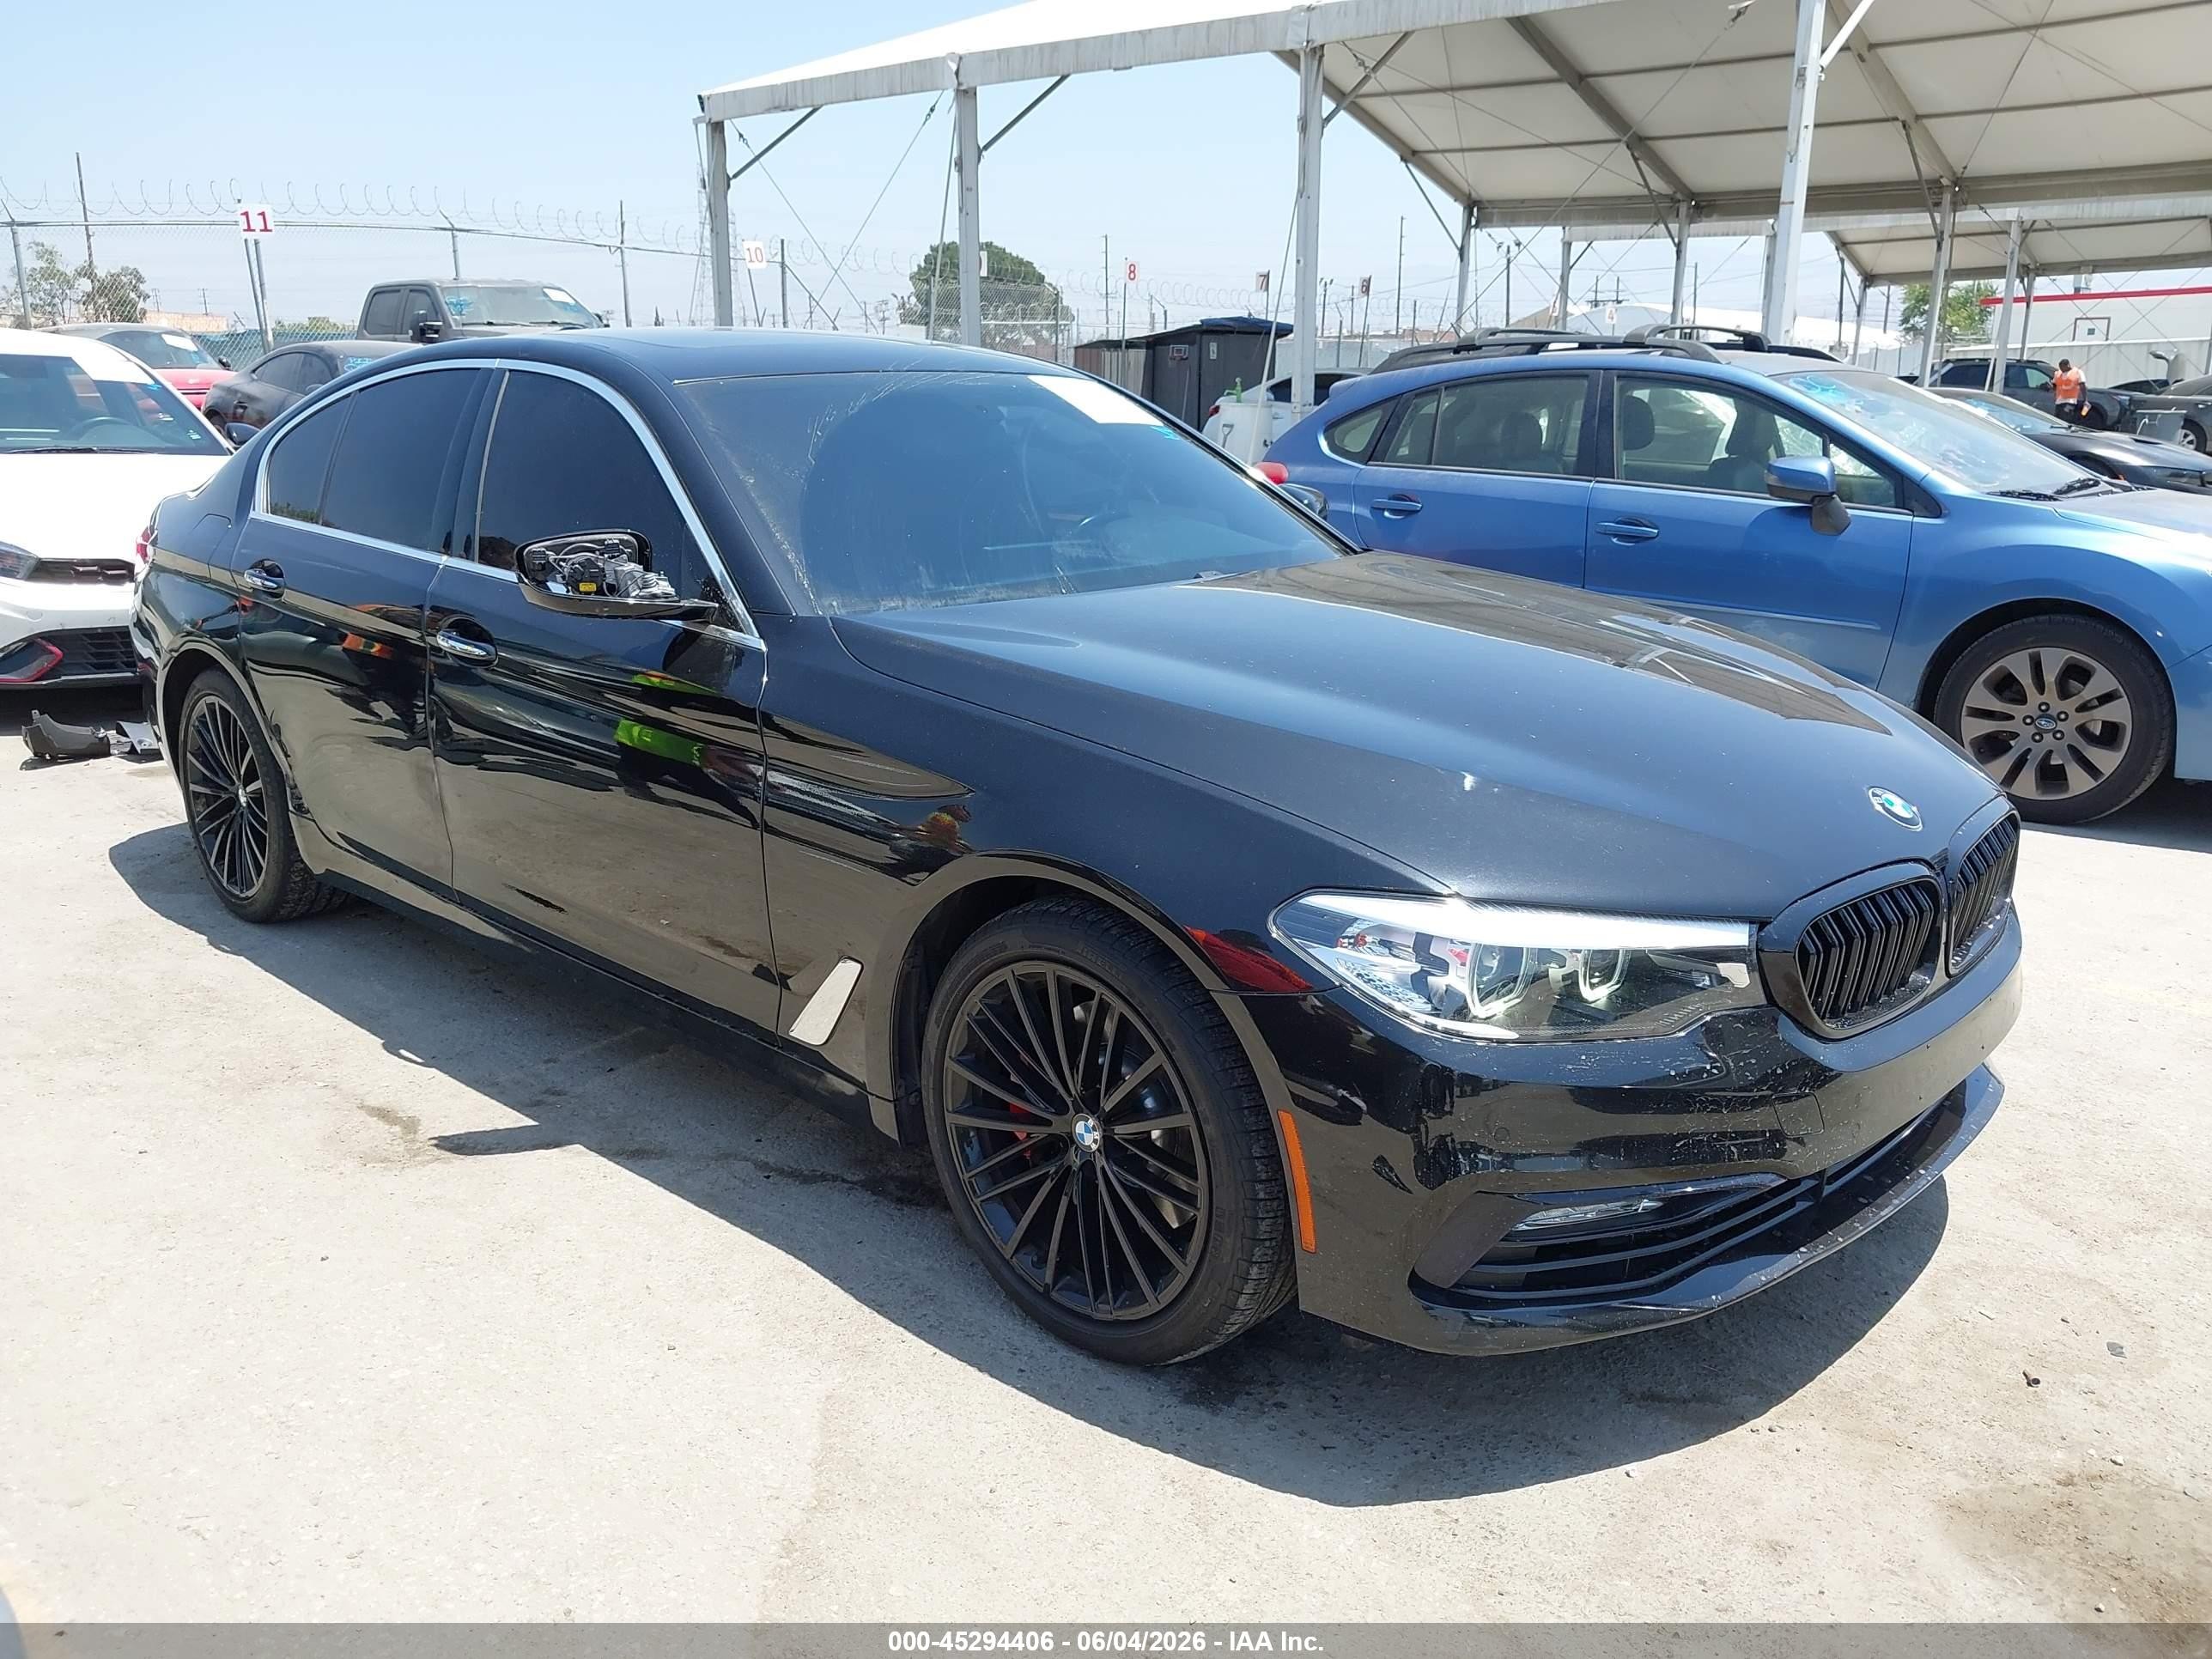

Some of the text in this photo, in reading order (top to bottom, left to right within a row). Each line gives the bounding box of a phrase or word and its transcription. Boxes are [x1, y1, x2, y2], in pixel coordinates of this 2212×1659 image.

[240, 210, 272, 232] 11
[746, 246, 763, 263] 10
[1128, 264, 1136, 281] 8
[1259, 274, 1267, 289] 7
[1361, 278, 1368, 294] 6
